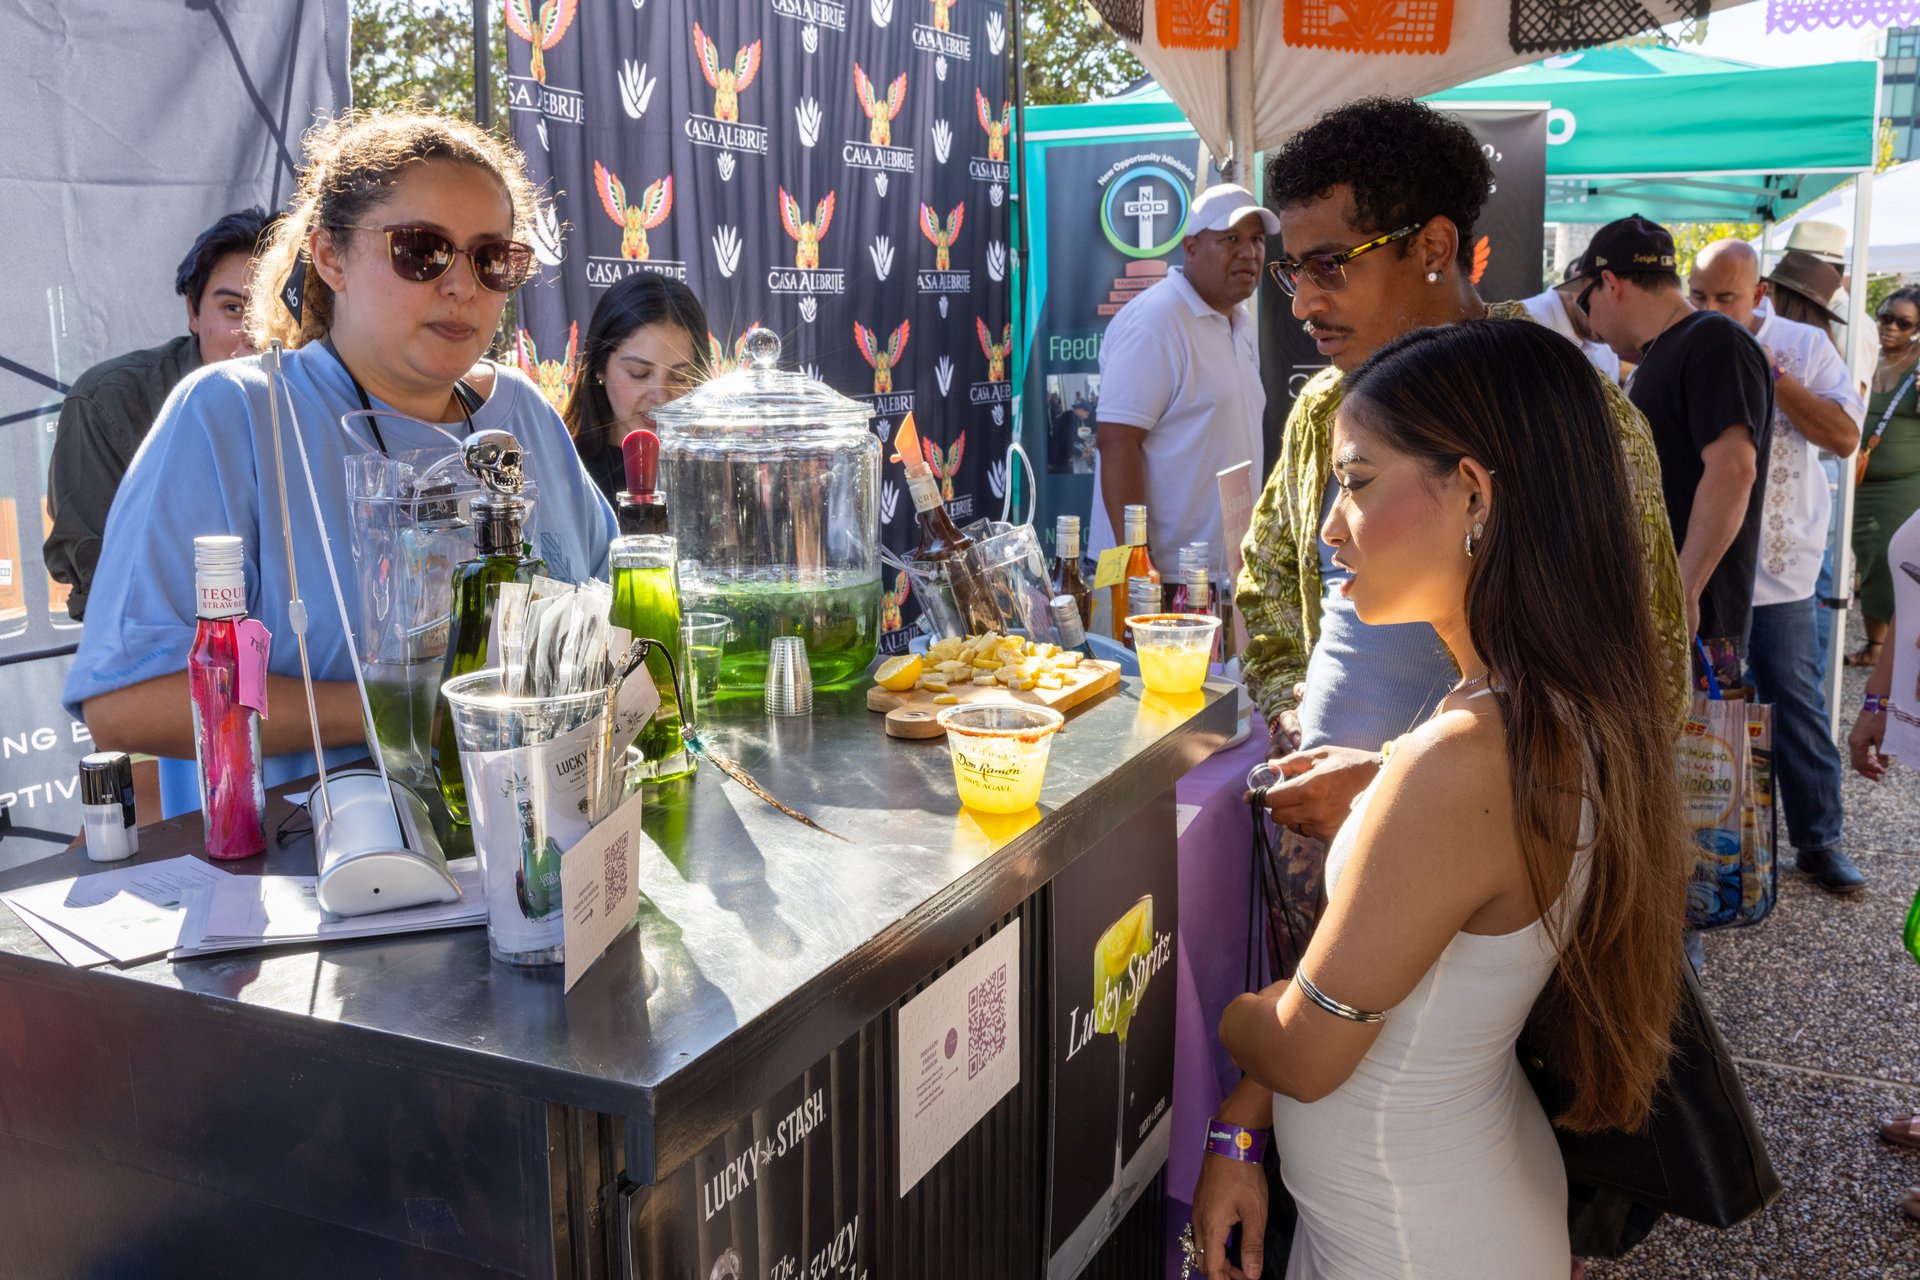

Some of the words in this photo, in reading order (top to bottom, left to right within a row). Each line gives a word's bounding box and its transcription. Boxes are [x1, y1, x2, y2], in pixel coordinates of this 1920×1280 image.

[685, 119, 716, 142] CASA
[842, 145, 873, 166] CASA
[874, 147, 915, 172] ALEBRIJE
[1097, 168, 1115, 186] New
[1112, 152, 1162, 173] Opportunity
[1161, 153, 1196, 182] Ministries
[1127, 203, 1165, 213] GOD
[586, 261, 622, 285] CASA
[767, 271, 798, 290] CASA
[798, 271, 846, 294] ALEBRIJE
[556, 750, 588, 777] LUCKY
[955, 752, 977, 769] Don
[982, 783, 1012, 793] AGAVE
[1065, 975, 1122, 1062] Lucky
[1126, 931, 1171, 1011] Spritz
[704, 1140, 761, 1223] LUCKY
[776, 1087, 826, 1158] STASH
